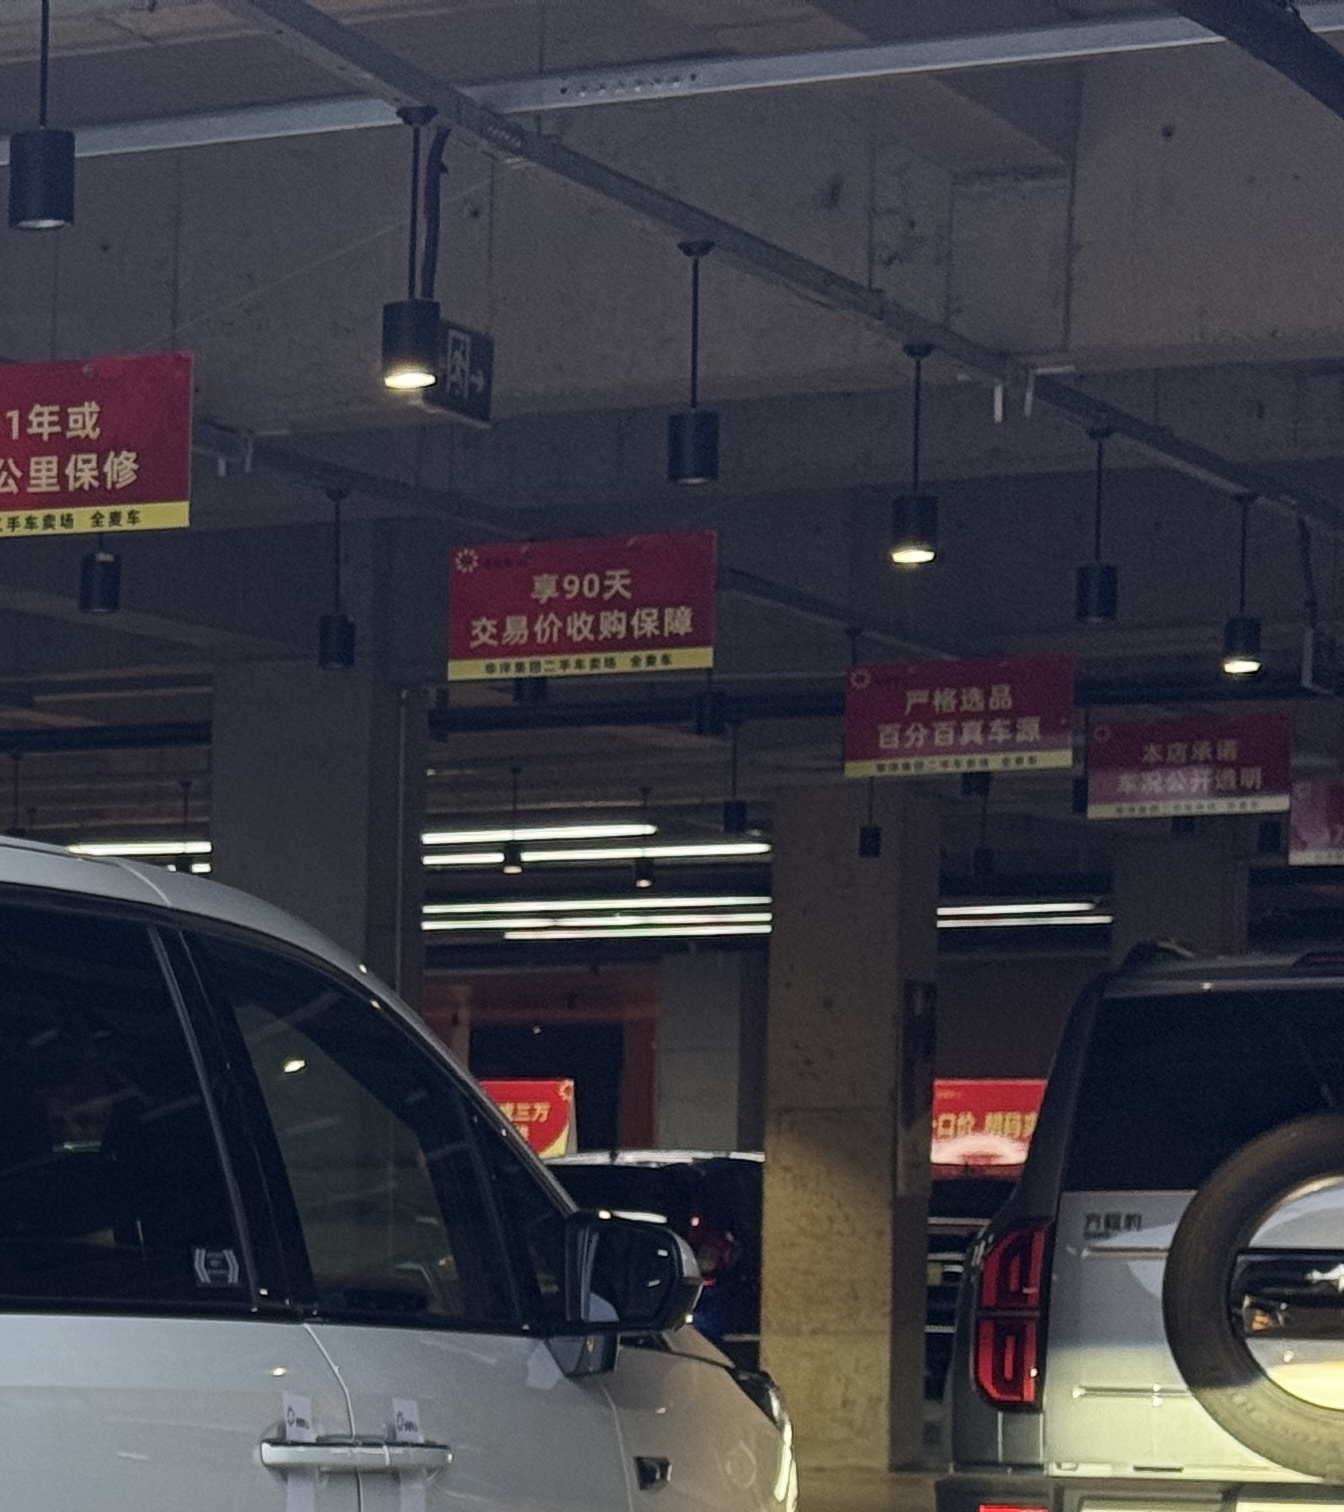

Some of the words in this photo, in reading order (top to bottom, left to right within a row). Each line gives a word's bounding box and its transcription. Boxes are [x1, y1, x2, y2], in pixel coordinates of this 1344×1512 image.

[90, 509, 141, 528] 全麦车
[531, 569, 632, 604] 享90天
[470, 605, 694, 648] 交易价收购保障
[904, 683, 1012, 716] 严格选品
[878, 715, 1041, 749] 百分百真车源
